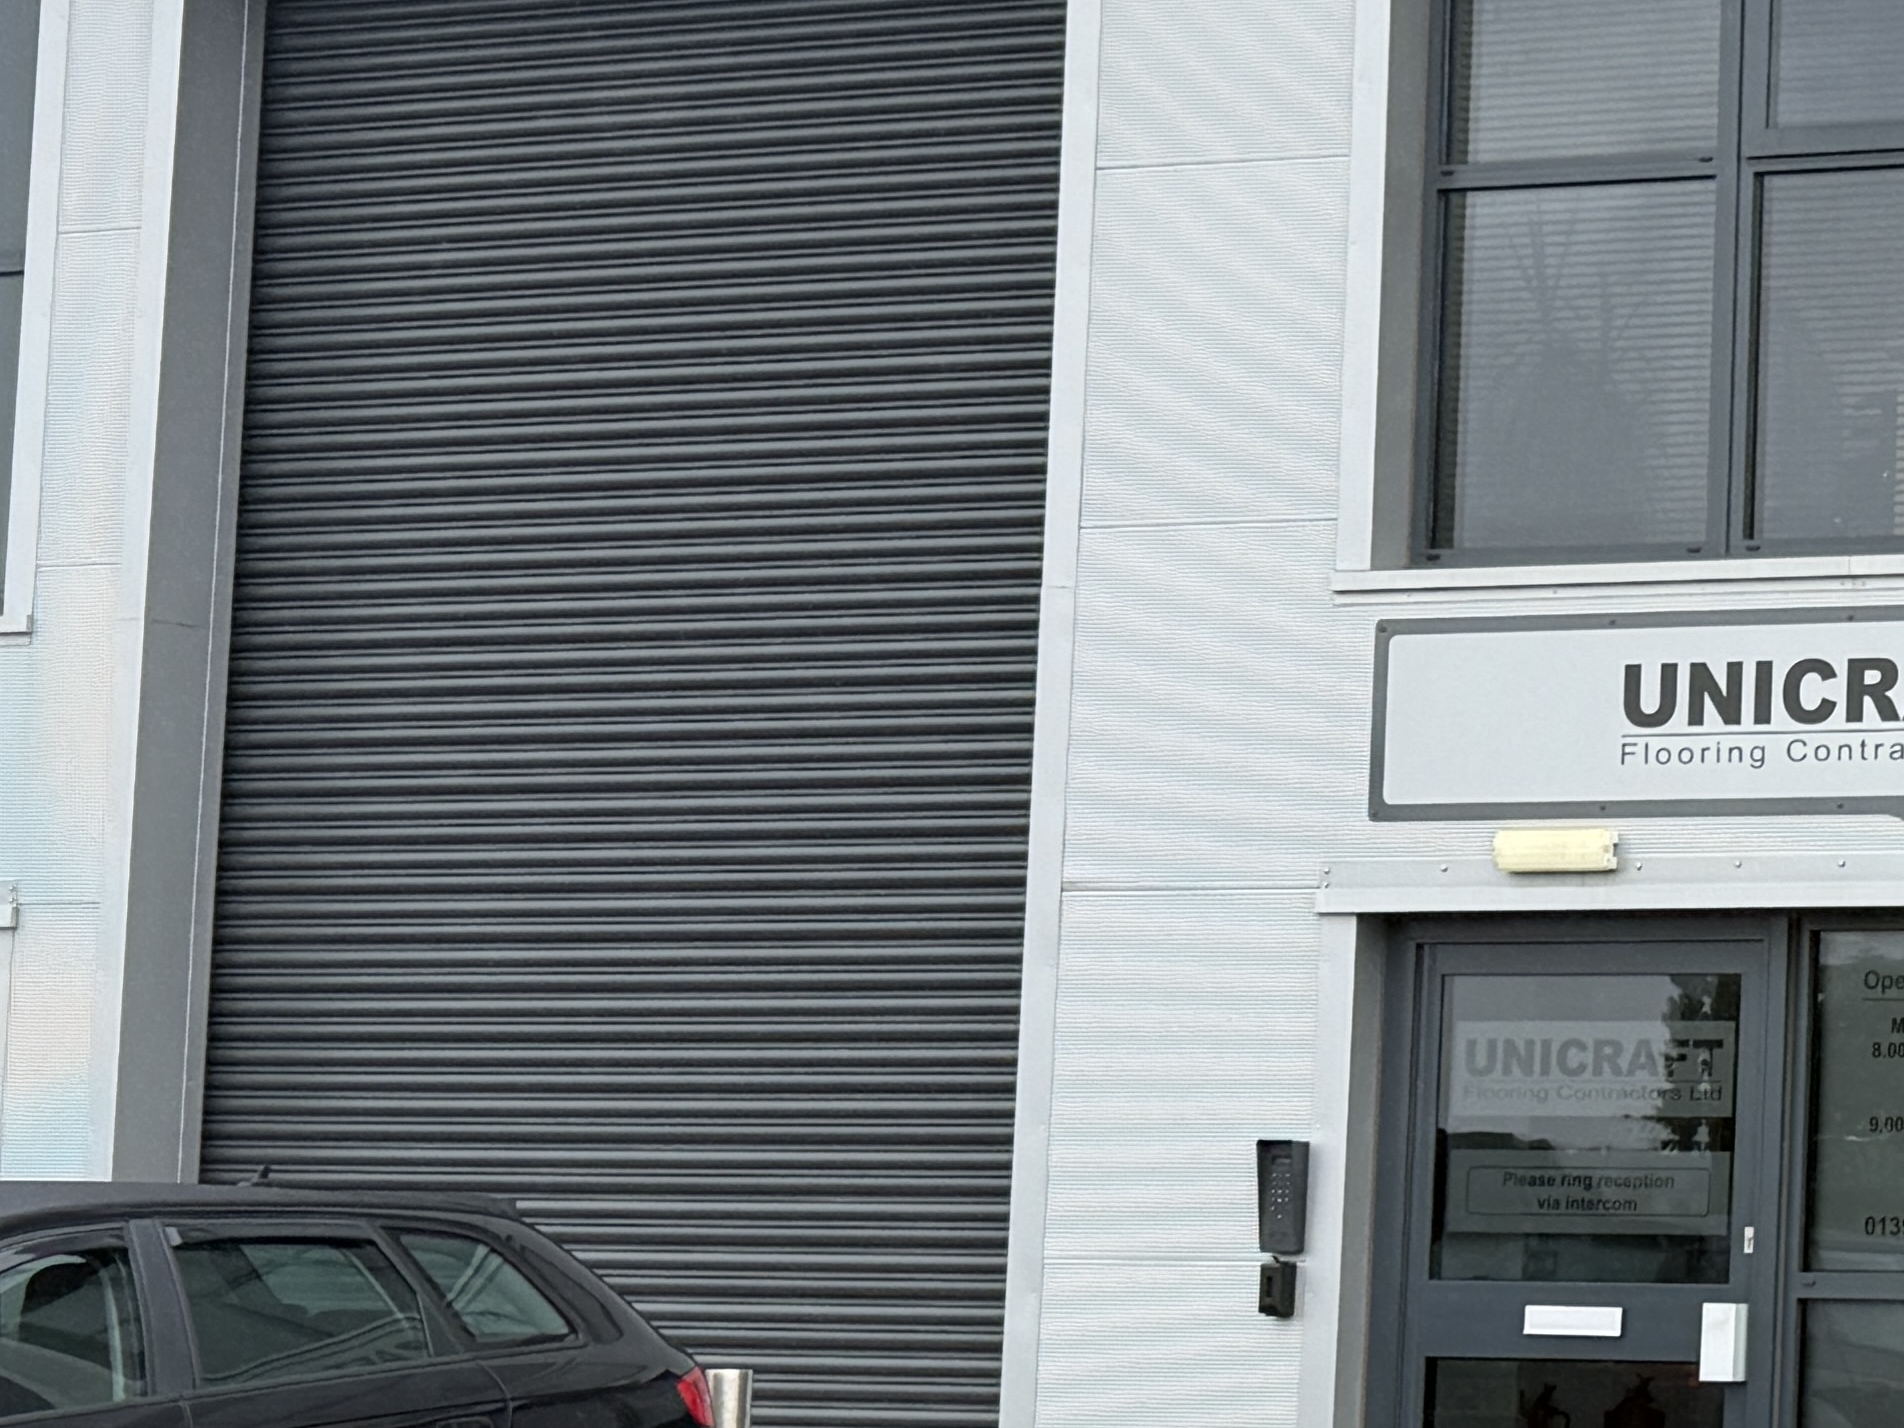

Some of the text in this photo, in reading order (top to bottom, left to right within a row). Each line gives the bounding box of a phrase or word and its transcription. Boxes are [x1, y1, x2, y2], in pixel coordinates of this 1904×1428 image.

[1620, 739, 1767, 769] Flooring
[1464, 1038, 1724, 1079] UNICRAFT
[1463, 1083, 1722, 1105] Flooring Contractors Ltd
[1503, 1170, 1675, 1191] Please ring reception
[1537, 1195, 1638, 1211] via intercom
